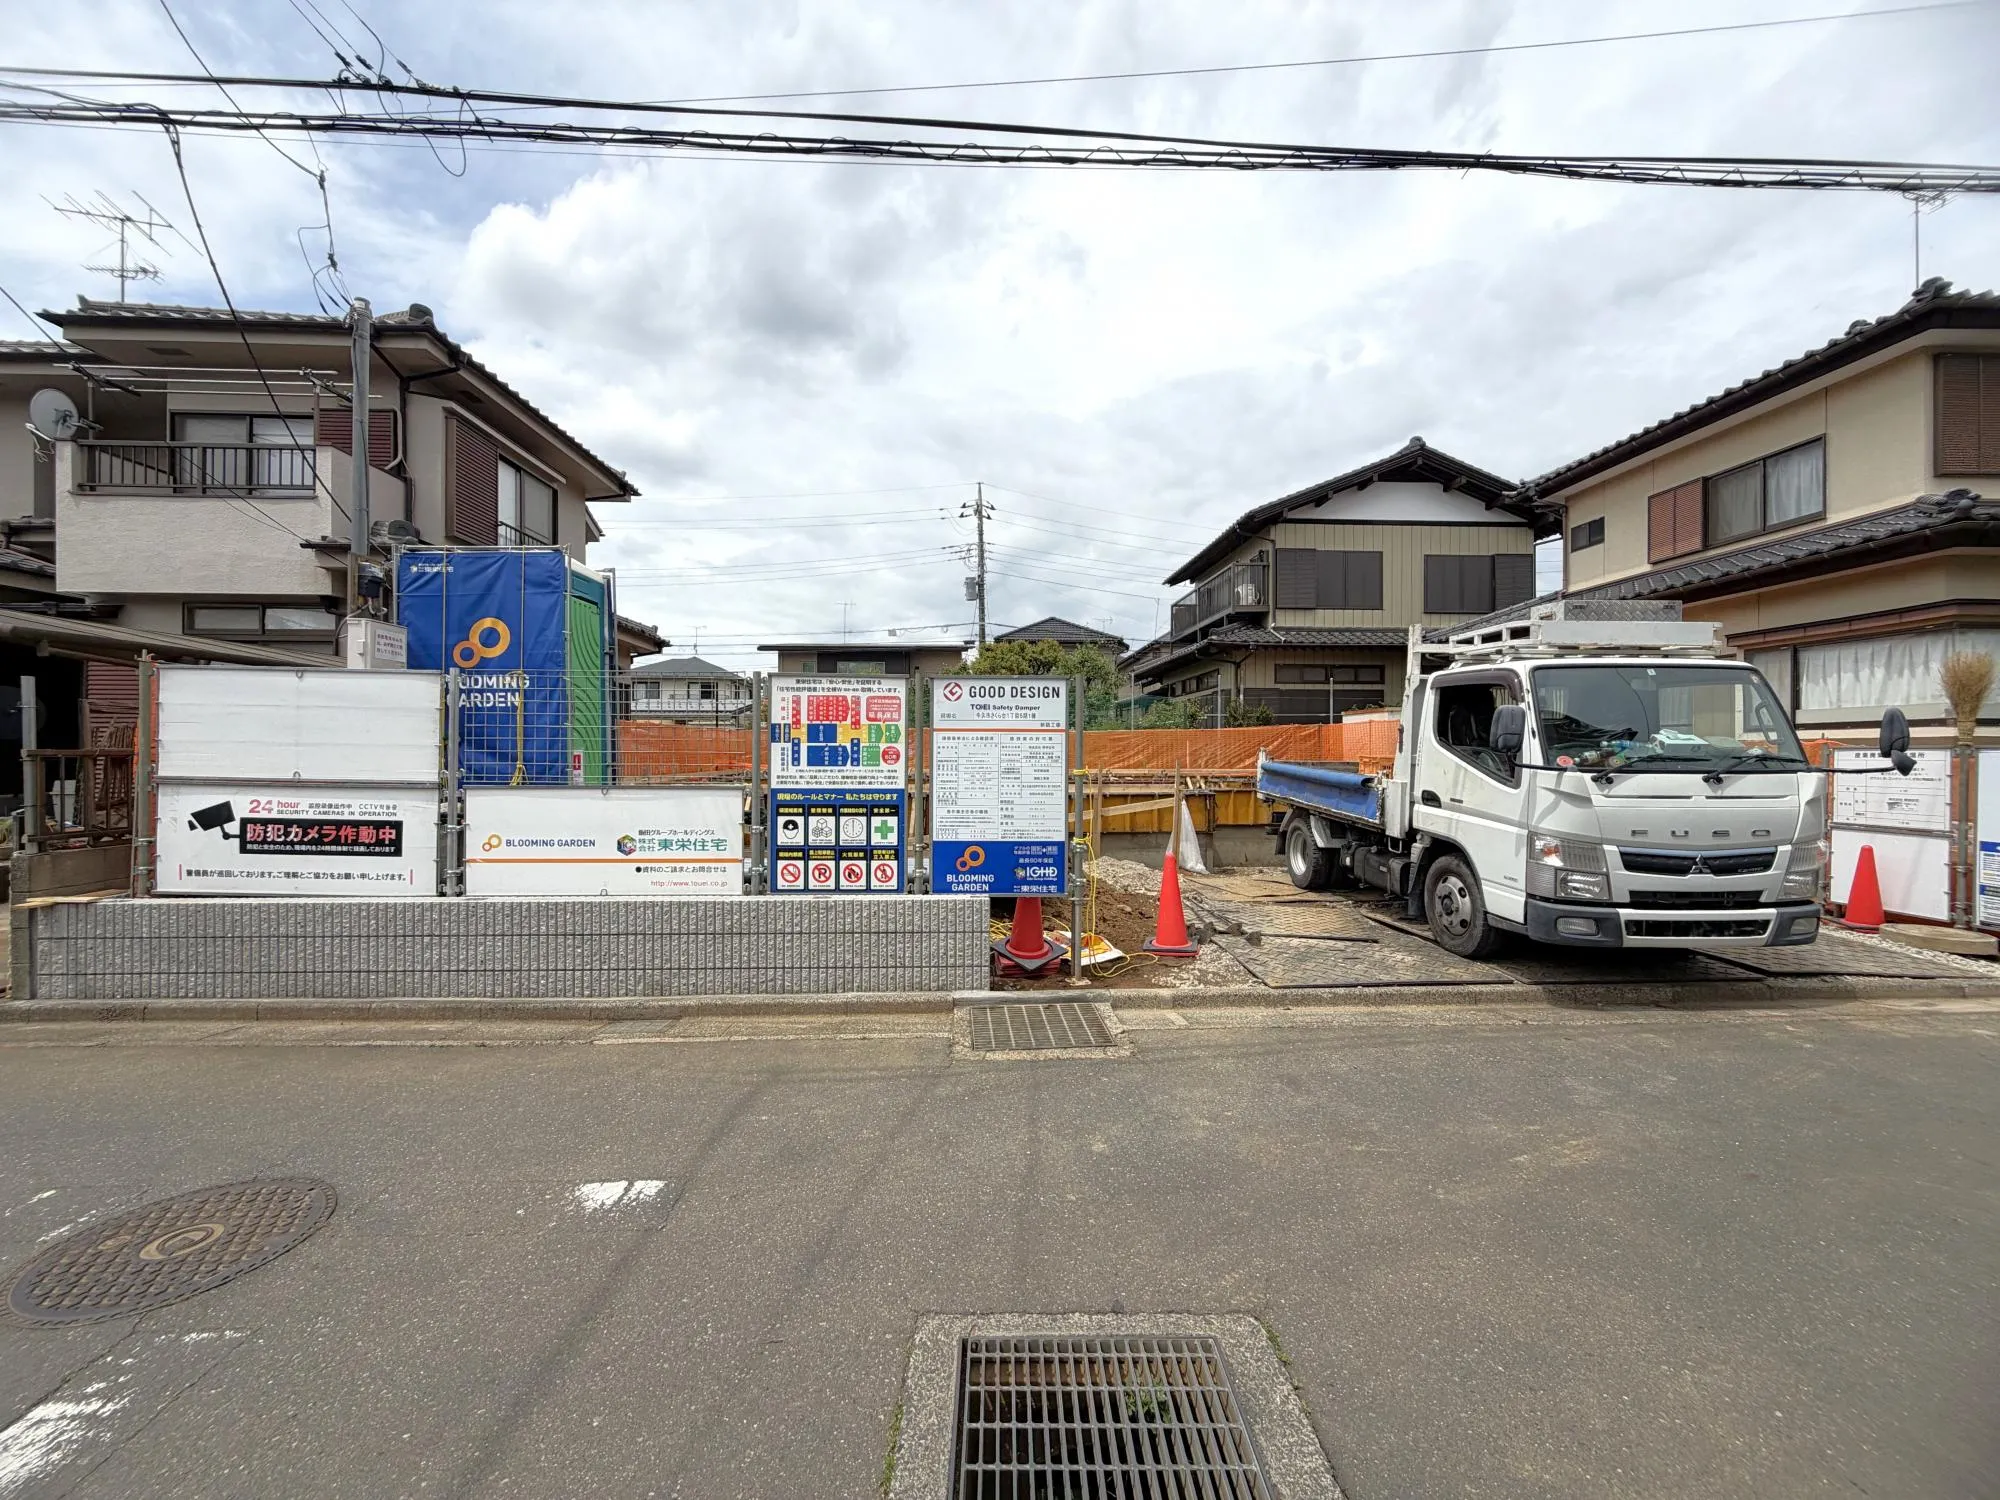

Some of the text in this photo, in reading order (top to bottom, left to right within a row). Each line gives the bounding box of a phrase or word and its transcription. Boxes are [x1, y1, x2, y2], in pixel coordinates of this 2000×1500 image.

[446, 673, 530, 689] OOMING
[969, 686, 1060, 699] GOOD DESIGN
[248, 799, 273, 814] 24
[276, 800, 300, 809] hour
[246, 823, 396, 844] 防犯カメラ作動中
[1630, 829, 1771, 837] FUSO
[505, 839, 596, 848] BLOOMING GARDEN
[657, 838, 728, 852] 東栄住宅
[186, 869, 407, 882] 警備員が巡回しております。ご理解とご協力をお願い申し上げます。
[946, 874, 995, 882] BLOOMING
[951, 883, 989, 892] GARDEN
